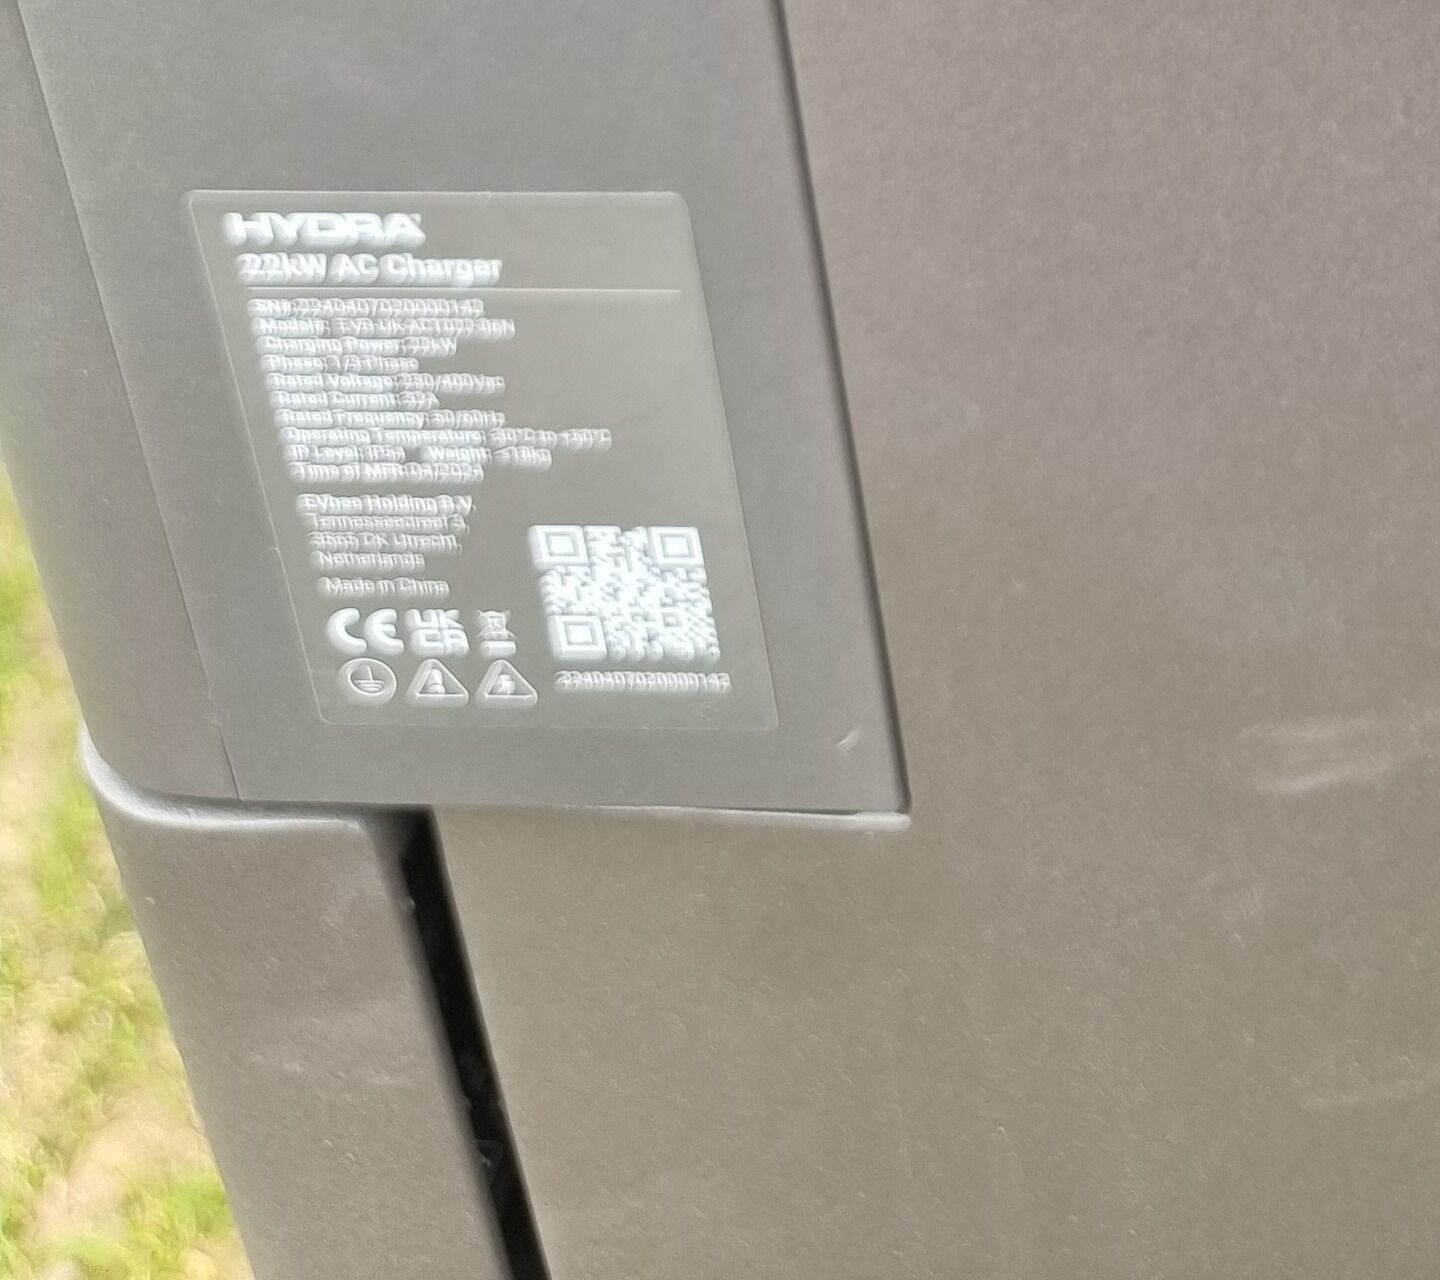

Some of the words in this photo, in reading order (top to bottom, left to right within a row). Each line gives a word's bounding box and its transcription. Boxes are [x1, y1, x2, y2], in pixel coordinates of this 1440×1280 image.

[223, 212, 426, 247] HYDRA
[236, 252, 327, 284] 22kW
[328, 252, 380, 284] AC
[380, 252, 502, 288] Charger
[314, 550, 426, 570] Netherlands
[321, 577, 374, 596] Made
[376, 578, 394, 596] in
[394, 578, 450, 596] China
[327, 607, 404, 656] CE
